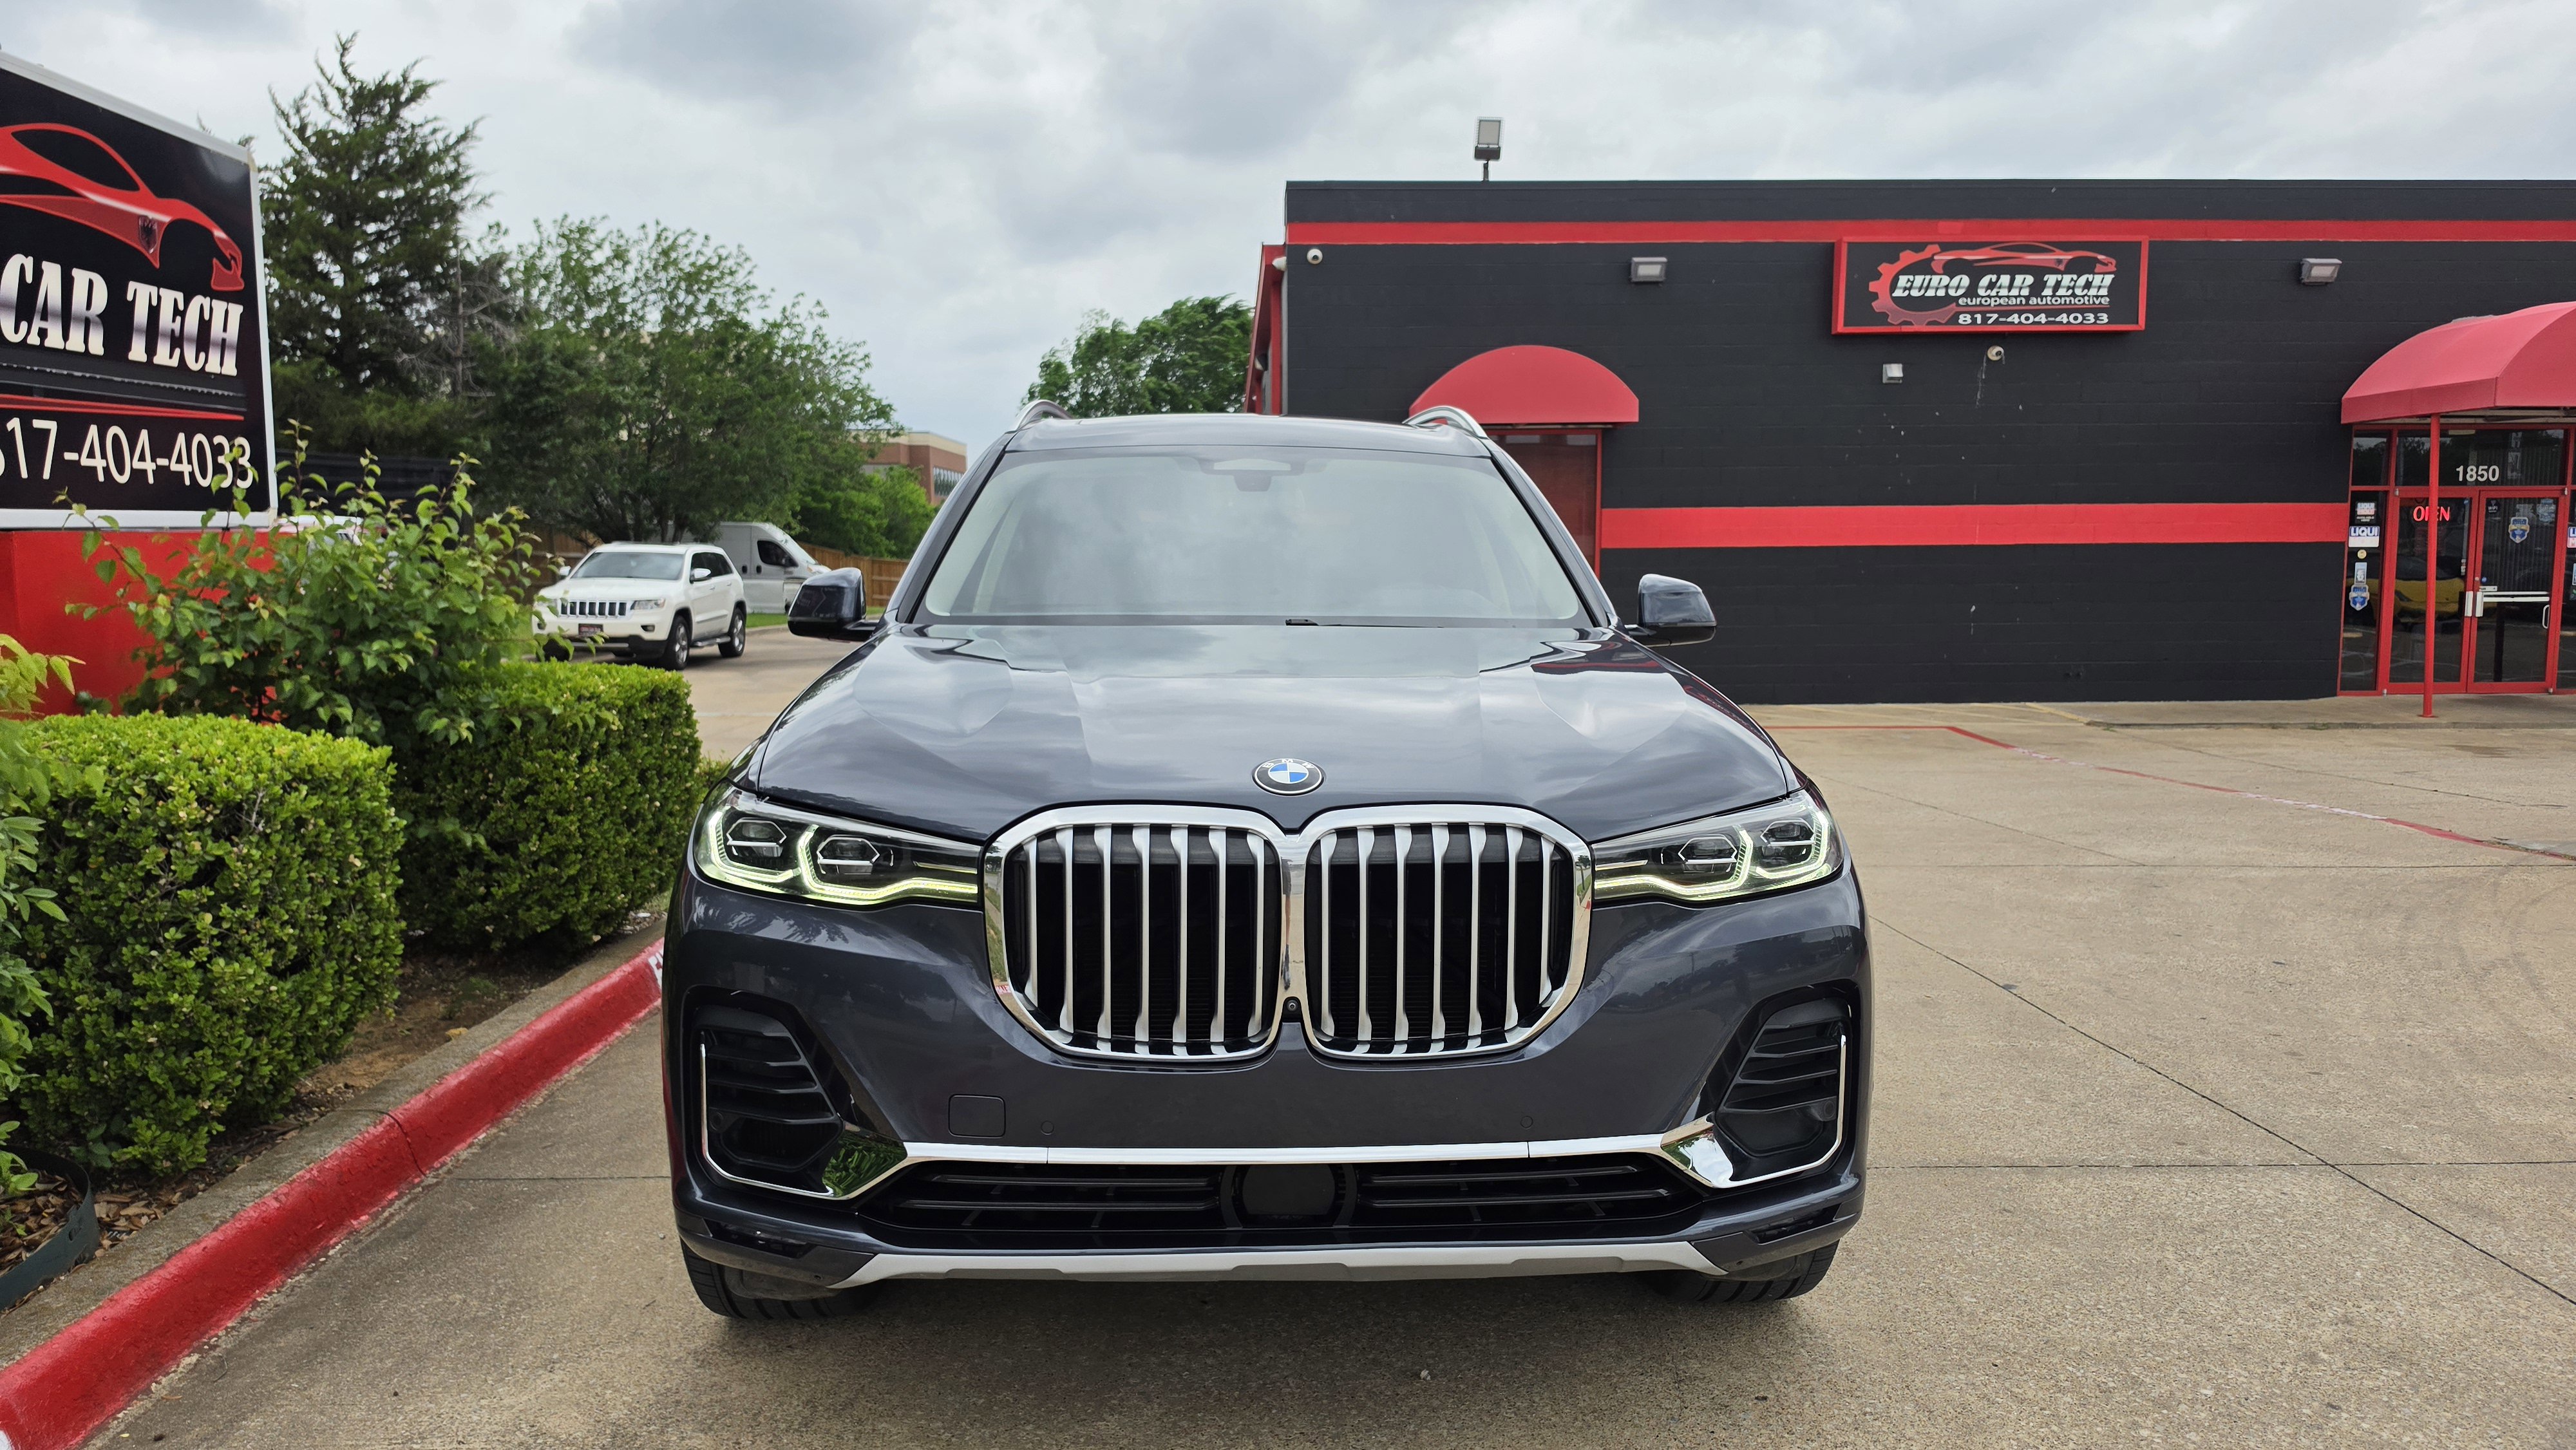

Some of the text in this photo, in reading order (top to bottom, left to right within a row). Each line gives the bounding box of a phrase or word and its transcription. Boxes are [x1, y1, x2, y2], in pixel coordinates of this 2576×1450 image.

[1892, 274, 2115, 297] EURO CAR TECH
[1958, 296, 2110, 307] european automotive
[0, 254, 243, 376] CAR TECH
[1958, 313, 2109, 325] 817-404-4033
[0, 417, 254, 489] 17-404-4033
[2456, 465, 2499, 482] 1850
[2351, 527, 2378, 537] LIQUI
[1262, 758, 1315, 769] BMW
